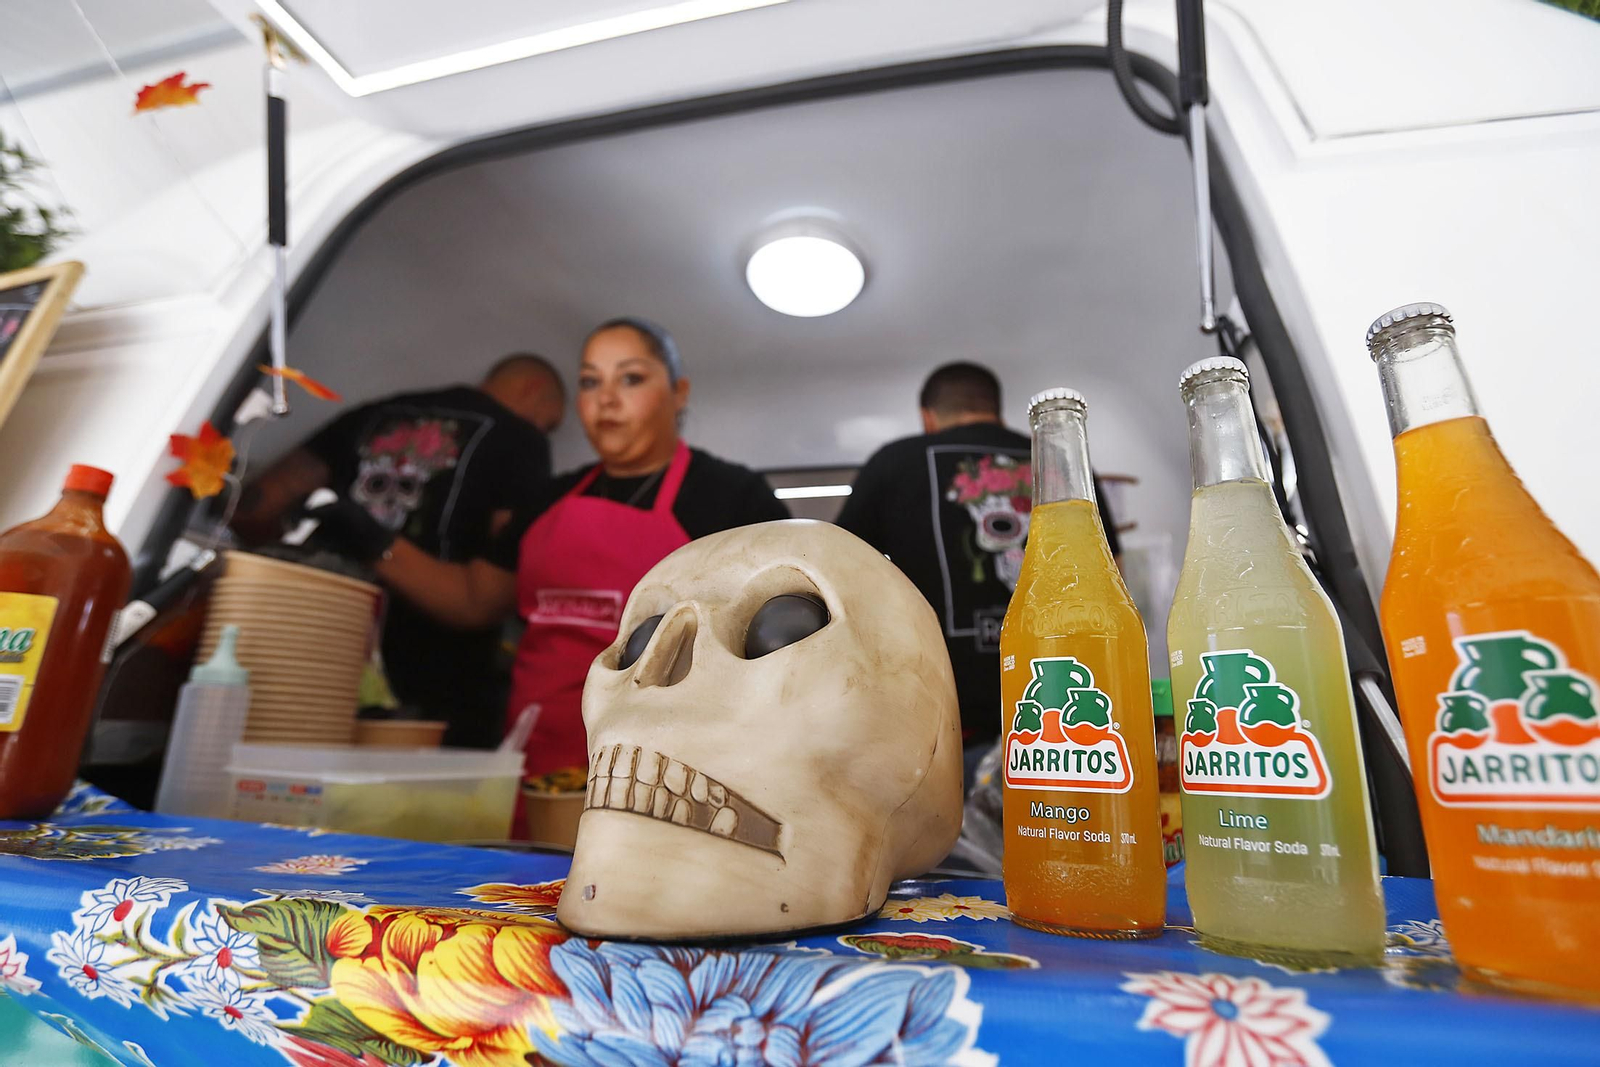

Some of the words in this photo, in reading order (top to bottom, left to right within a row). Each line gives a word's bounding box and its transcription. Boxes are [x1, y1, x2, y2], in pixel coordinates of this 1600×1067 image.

[1010, 748, 1117, 775] JARRITOS
[1185, 751, 1309, 779] JARRITOS
[1441, 753, 1600, 784] JARRITO
[1030, 801, 1091, 825] Mango
[1218, 808, 1269, 830] Lime
[1017, 825, 1047, 839] Natural
[1049, 827, 1081, 841] Flavor
[1083, 830, 1111, 843] Soda
[1198, 834, 1232, 849] Natural
[1233, 837, 1272, 853] Flavor
[1274, 840, 1309, 856] Soda
[1475, 822, 1600, 849] Mandari
